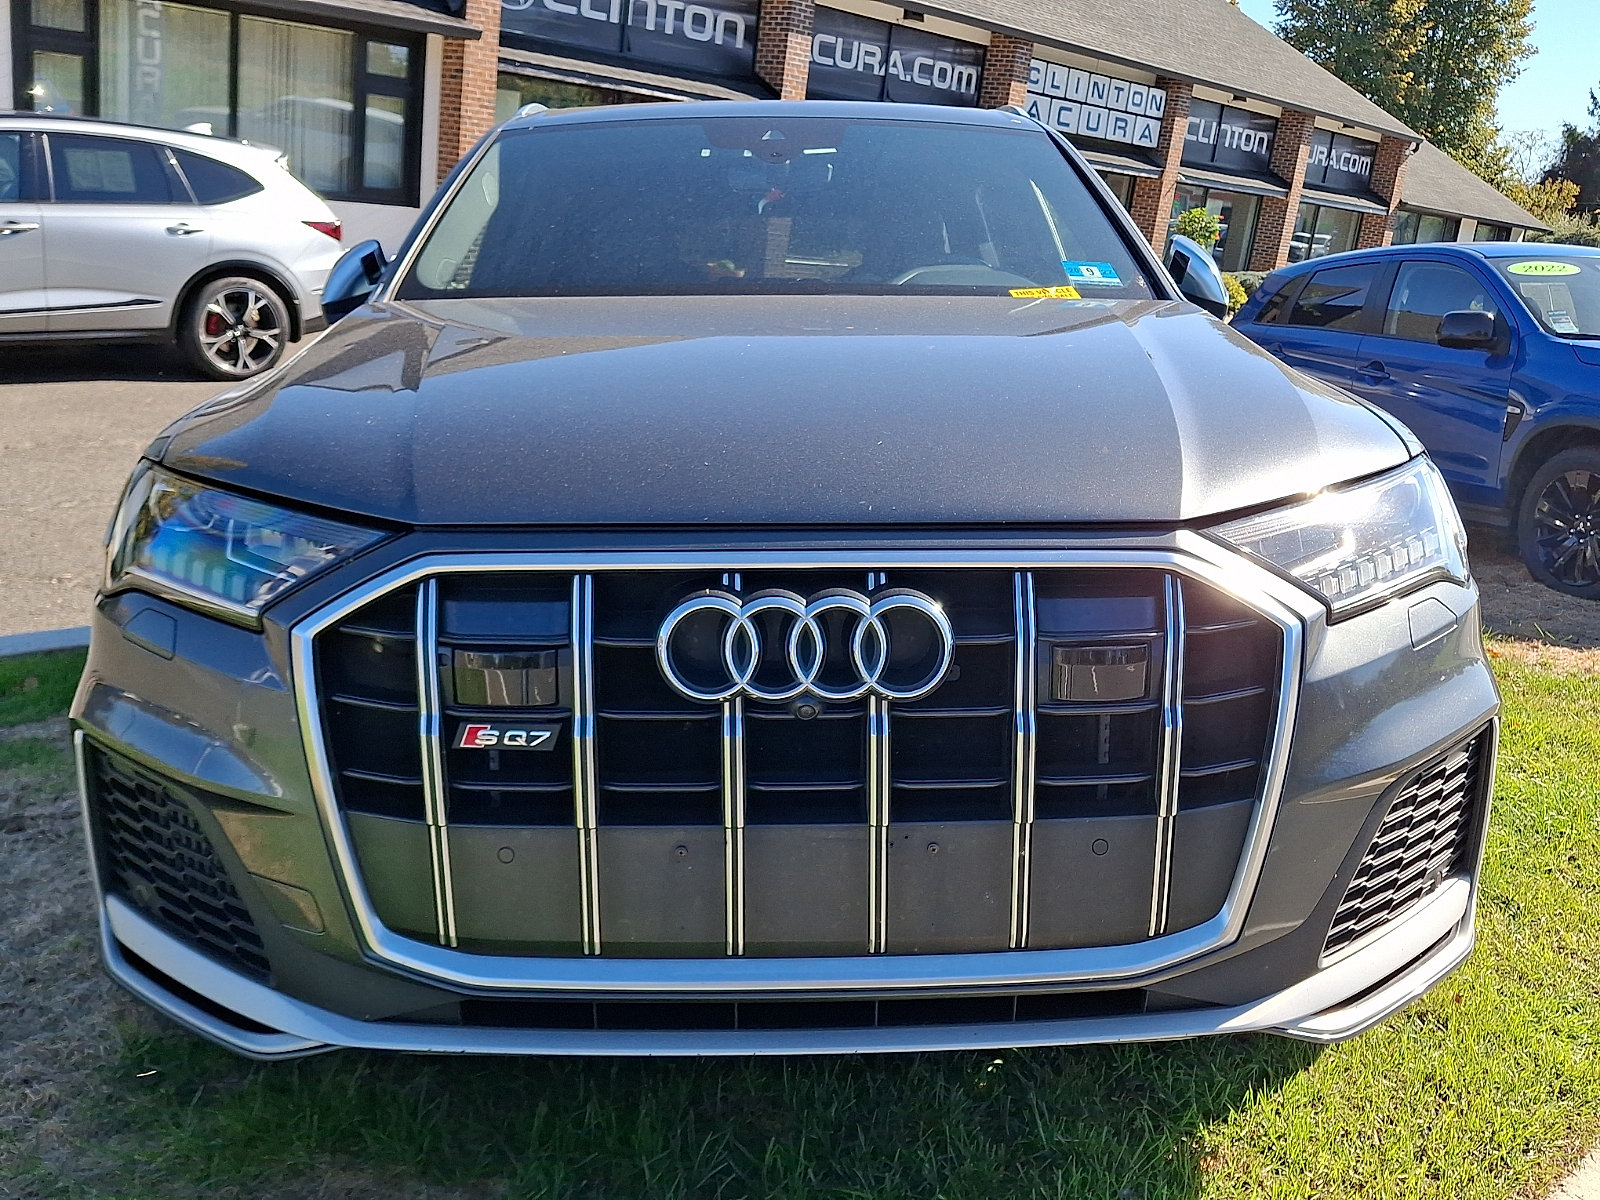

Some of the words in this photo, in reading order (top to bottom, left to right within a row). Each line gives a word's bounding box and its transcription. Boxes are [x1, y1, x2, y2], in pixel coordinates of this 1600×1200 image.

[810, 33, 977, 95] CURA.COM
[1027, 66, 1163, 112] CLINTON
[1027, 100, 1153, 143] ACURA
[1086, 267, 1095, 276] 9
[1522, 265, 1568, 273] 2022
[474, 730, 552, 747] SQ7
